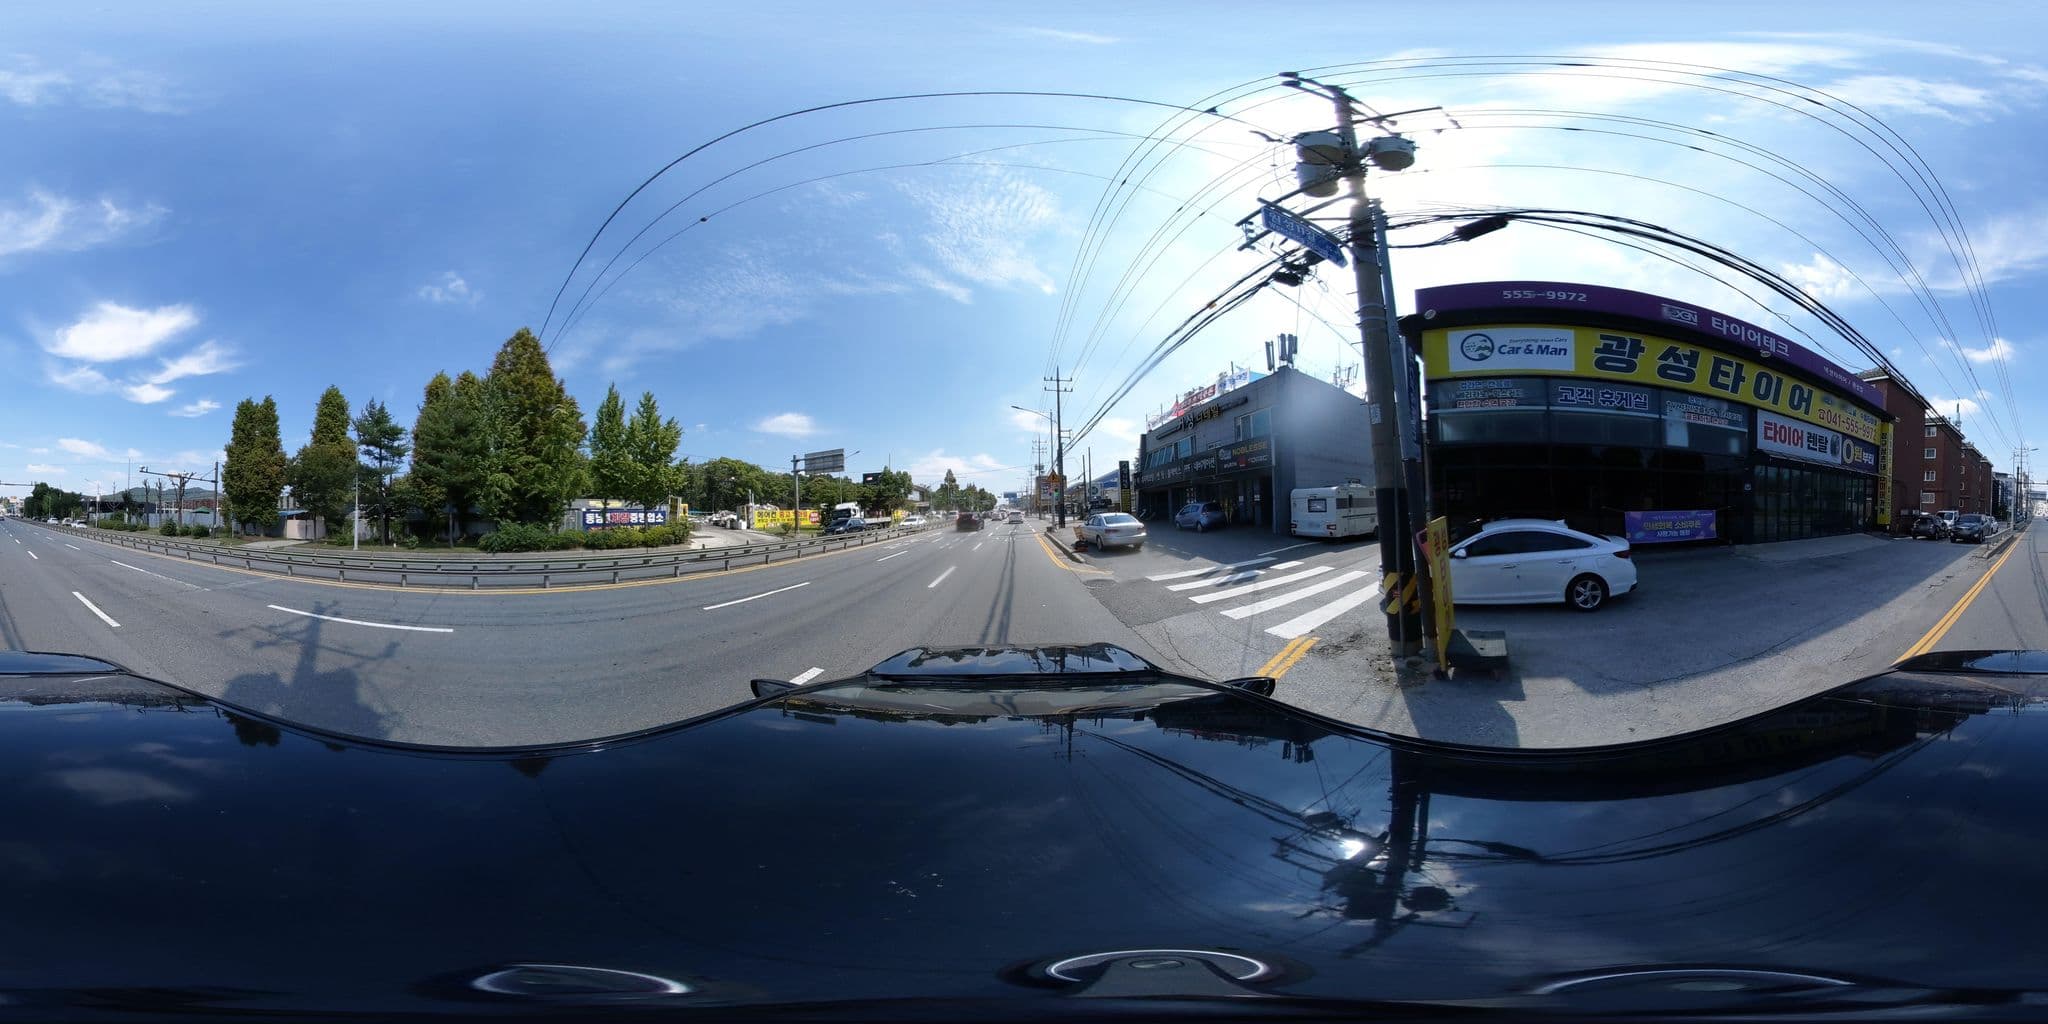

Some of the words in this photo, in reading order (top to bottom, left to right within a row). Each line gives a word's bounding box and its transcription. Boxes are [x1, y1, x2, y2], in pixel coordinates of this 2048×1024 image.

[1502, 290, 1588, 302] 555-9972
[1498, 344, 1521, 355] Car
[1524, 345, 1534, 355] &
[1536, 344, 1567, 356] Man
[1711, 316, 1790, 357] 타이어테크
[1593, 333, 1815, 416] 광성타이어
[1558, 386, 1595, 405] 고객
[1599, 388, 1648, 410] 휴게실
[1763, 419, 1803, 448] 타이어
[1807, 431, 1829, 454] 렌탈
